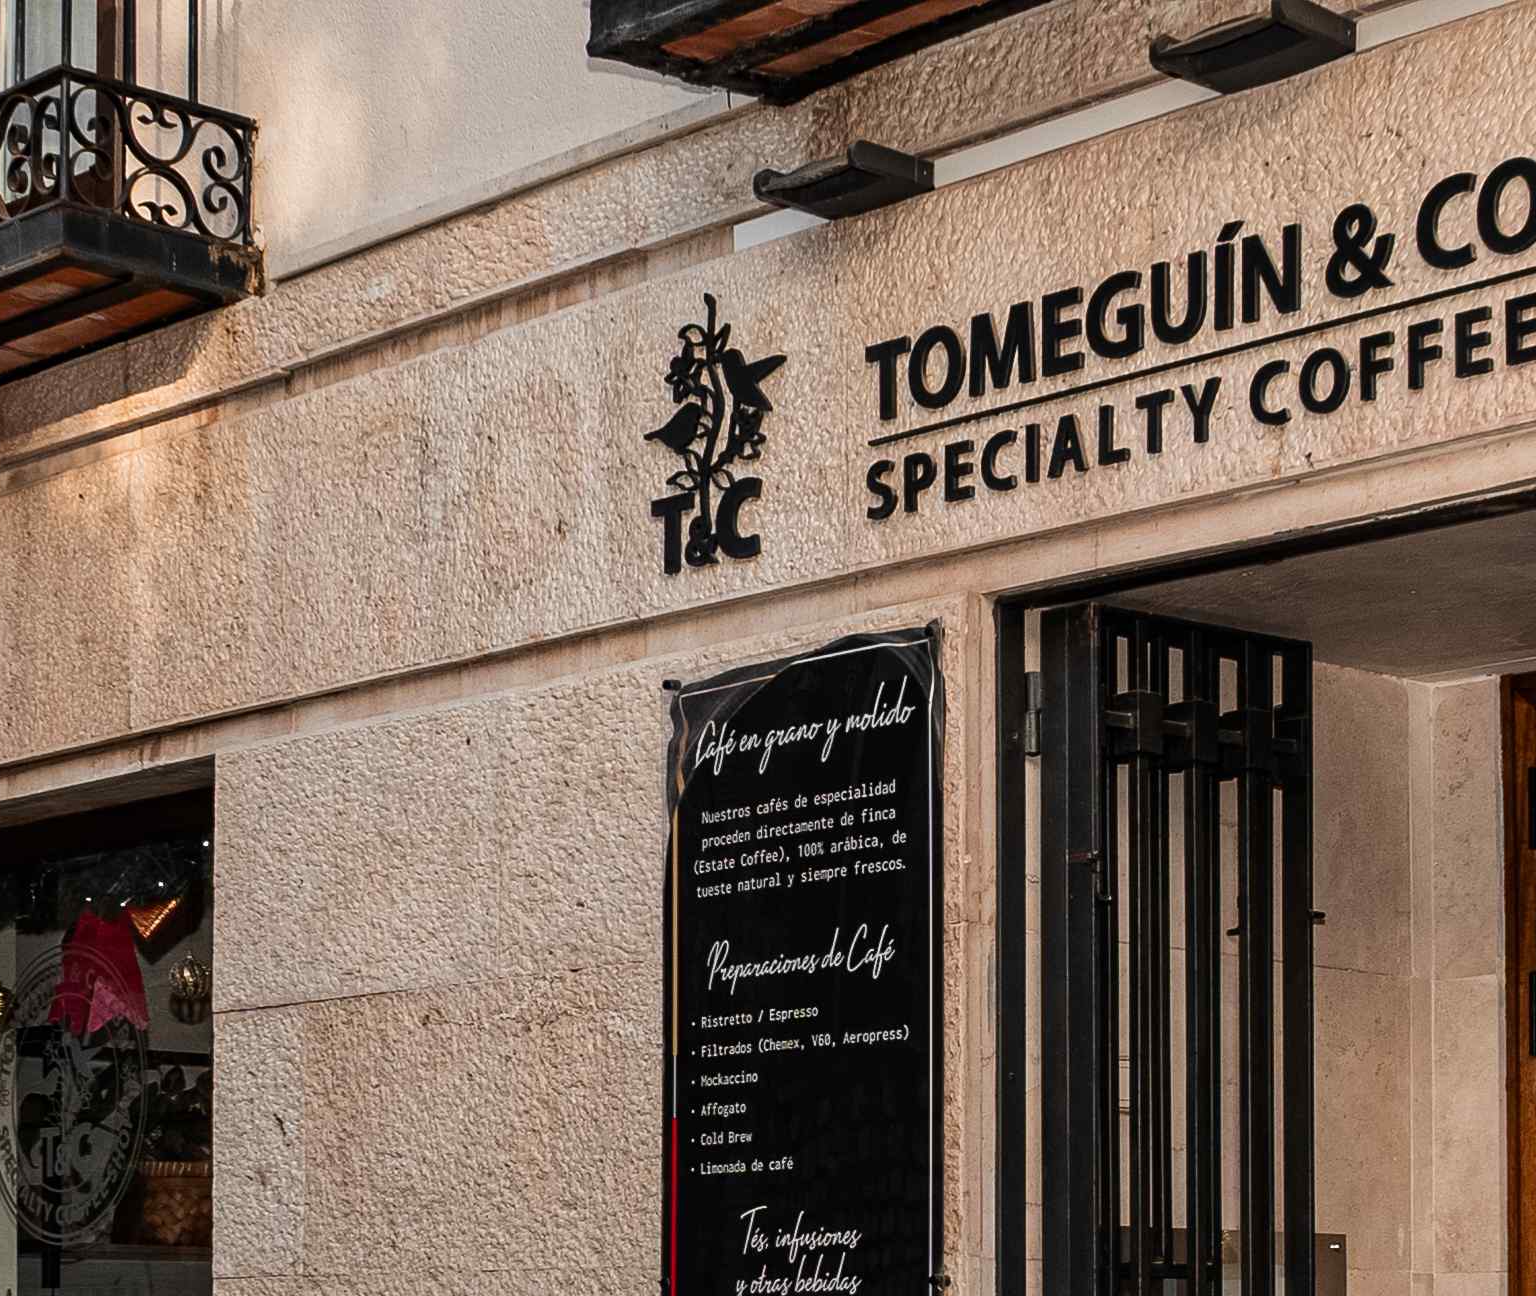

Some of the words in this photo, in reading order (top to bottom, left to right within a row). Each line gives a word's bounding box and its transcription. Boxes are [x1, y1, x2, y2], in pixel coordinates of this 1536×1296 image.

[864, 220, 1301, 420] TOMEGUÍN
[1325, 203, 1395, 298] &
[866, 377, 1221, 521] SPECIALTY
[650, 476, 762, 576] T&C
[695, 720, 736, 775] Café
[739, 733, 762, 751] en
[758, 722, 823, 774] grano
[821, 719, 842, 762] y
[846, 675, 916, 733] molido
[702, 807, 751, 825] Nuestros
[756, 798, 788, 815] cafés
[794, 795, 808, 808] de
[814, 779, 896, 805] especialidad
[702, 830, 751, 852] proceden
[756, 816, 834, 840] directamente
[841, 812, 854, 826] de
[861, 807, 896, 824] finca
[694, 857, 735, 875] (Estate
[740, 846, 790, 866] Coffee),
[798, 841, 824, 858] 100%
[830, 836, 884, 854] arábica,
[892, 831, 907, 844] de
[696, 881, 732, 898] tueste
[738, 872, 781, 892] natural
[787, 874, 795, 887] y
[801, 865, 847, 883] siempre
[854, 858, 906, 875] frescos.
[707, 940, 819, 995] Preparaciones
[821, 928, 844, 969] de
[847, 924, 896, 980] Café
[701, 1013, 753, 1029] Ristretto
[758, 1010, 764, 1022] /
[769, 1006, 819, 1021] Espresso
[701, 1041, 752, 1057] Filtrados
[758, 1038, 805, 1054] (Chemex,
[812, 1033, 836, 1048] V60,
[843, 1025, 910, 1045] Aeropress)
[701, 1071, 758, 1087] Mockaccino
[701, 1102, 746, 1117] Affogato
[700, 1132, 724, 1146] Cold
[728, 1131, 752, 1143] Brew
[700, 1159, 746, 1175] Limonada
[751, 1159, 763, 1171] de
[769, 1156, 794, 1171] café
[740, 1206, 769, 1254] Tés,
[775, 1210, 863, 1264] infusiones
[750, 1264, 792, 1296] otras
[794, 1252, 863, 1295] bebidas
